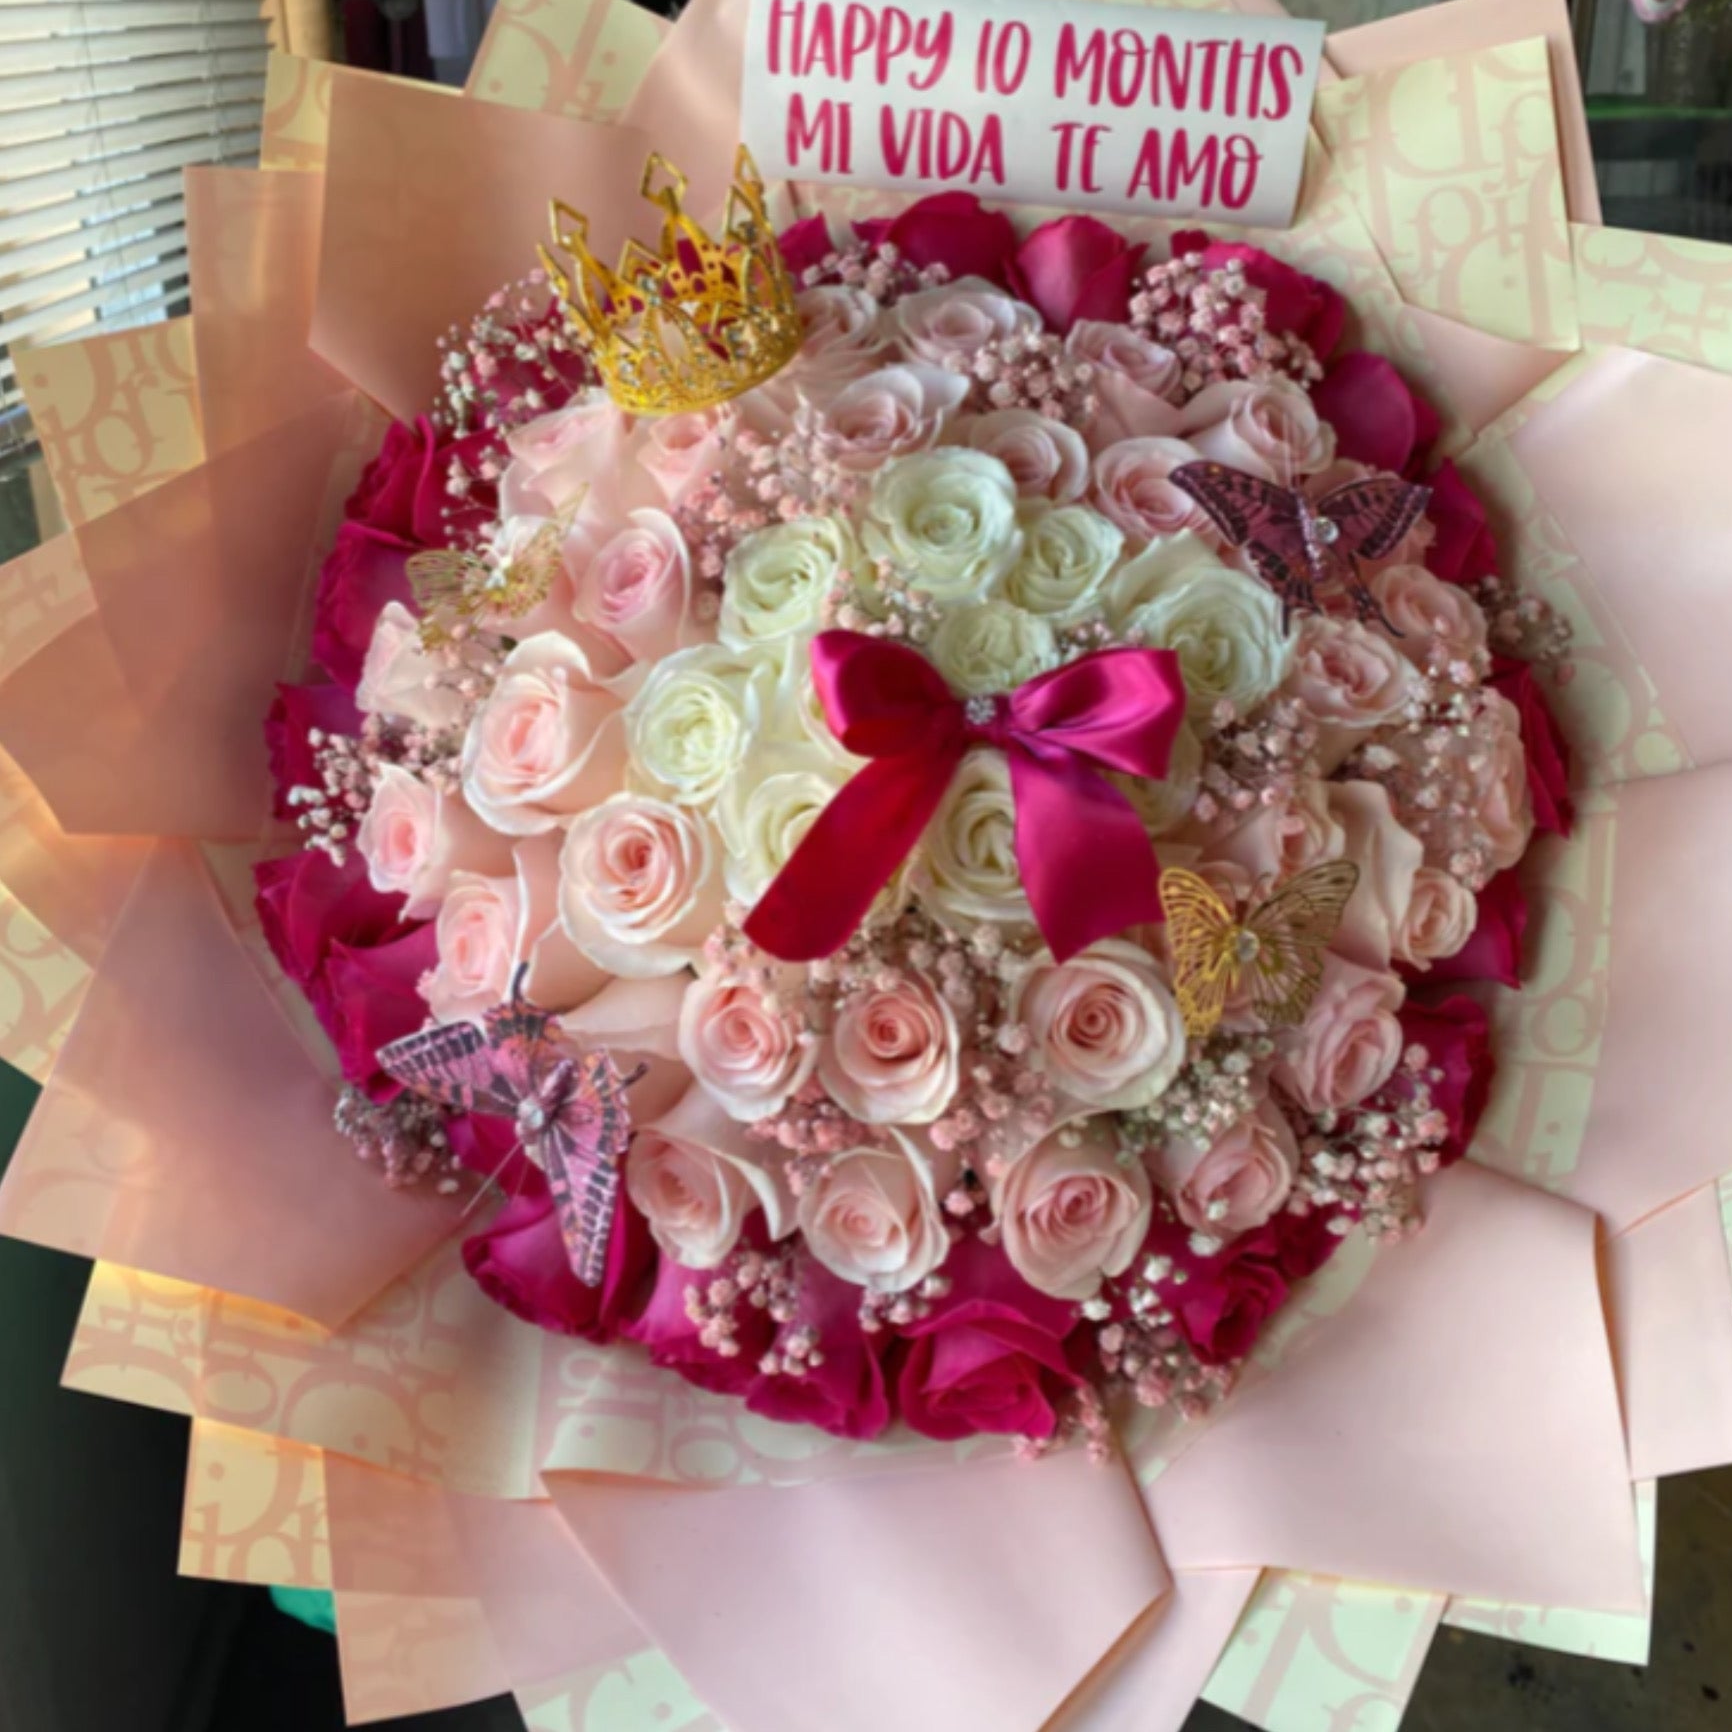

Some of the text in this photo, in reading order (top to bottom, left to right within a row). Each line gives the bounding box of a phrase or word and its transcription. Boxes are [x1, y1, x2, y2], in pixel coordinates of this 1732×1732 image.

[974, 19, 1033, 96] 10
[1053, 22, 1305, 121] MONTHS
[785, 92, 1265, 211] MI VIDA TE AMO
